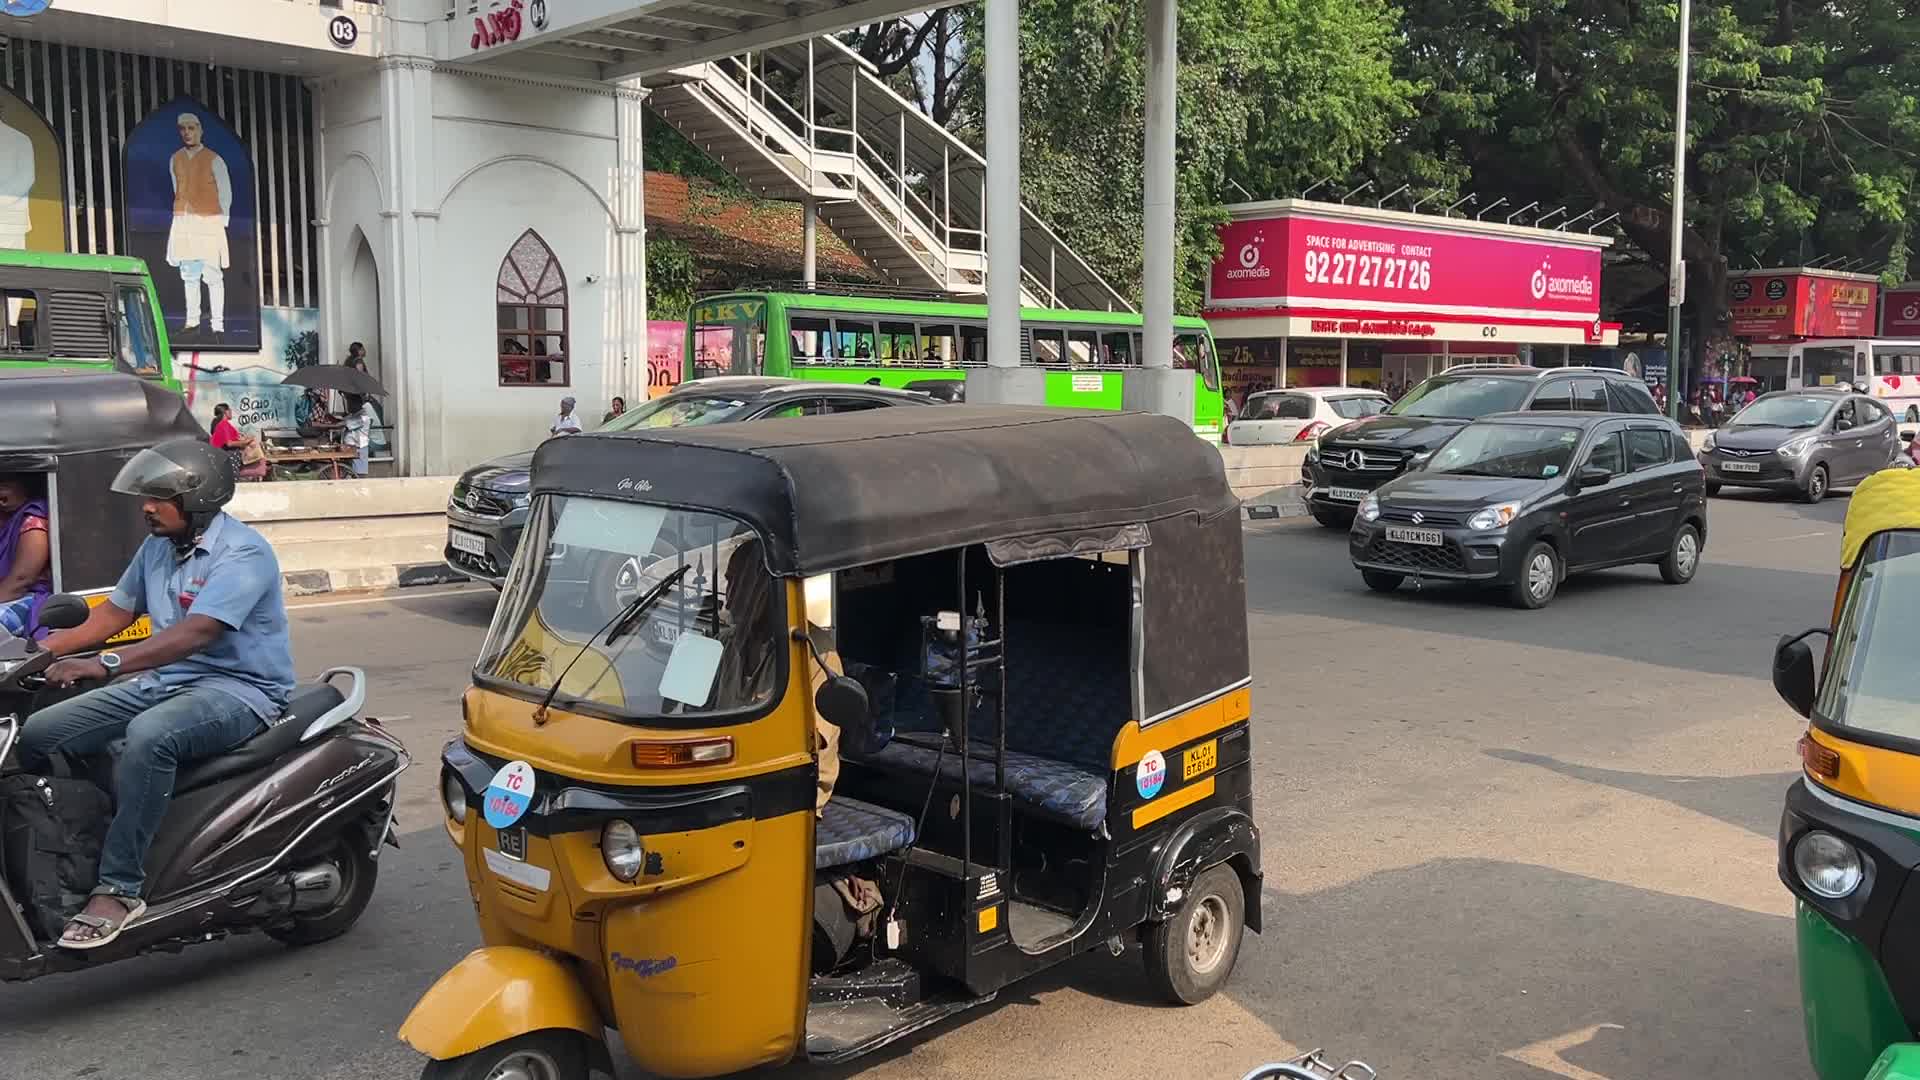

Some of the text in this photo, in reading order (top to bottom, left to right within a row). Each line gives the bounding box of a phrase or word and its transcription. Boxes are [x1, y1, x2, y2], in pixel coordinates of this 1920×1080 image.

[332, 21, 354, 40] 03
[1306, 234, 1432, 258] SPACE FOR ADVERTISING CONTACT
[1226, 266, 1270, 279] axomedia
[1548, 275, 1593, 294] axomedia
[1144, 759, 1157, 773] TC
[506, 773, 523, 790] TC
[489, 794, 519, 817] 10184
[500, 832, 521, 852] RE
